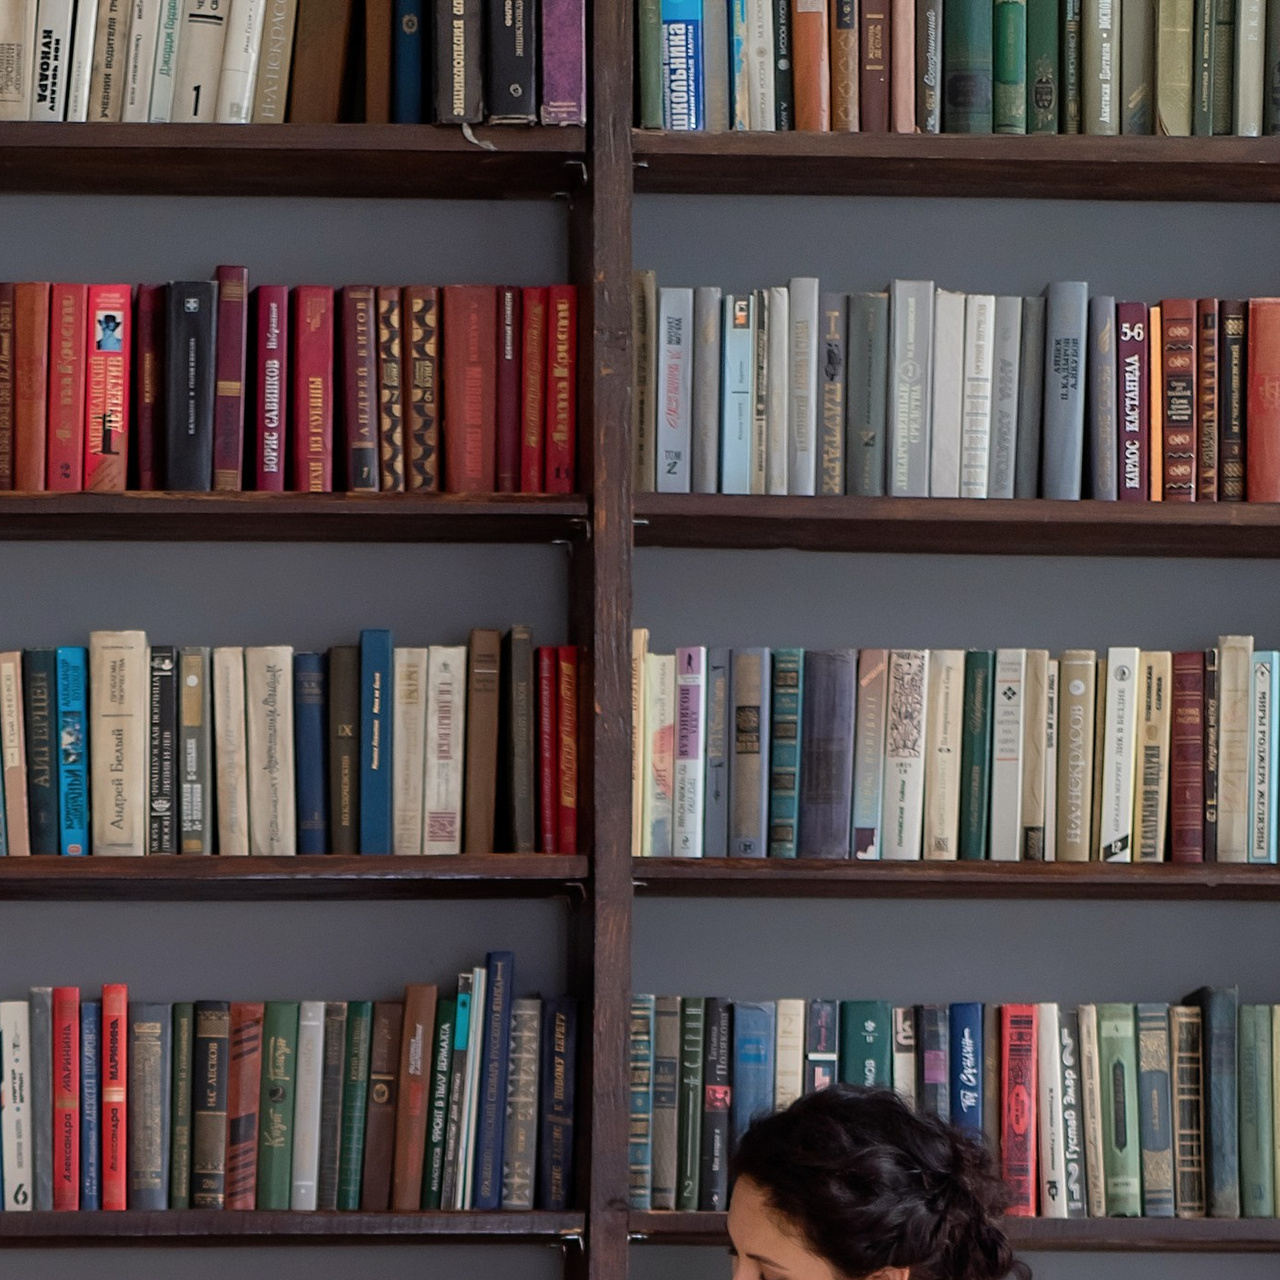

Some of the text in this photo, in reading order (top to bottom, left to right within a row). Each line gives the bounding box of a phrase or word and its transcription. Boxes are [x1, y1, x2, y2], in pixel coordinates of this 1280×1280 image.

[669, 23, 688, 130] ШКОЛЬНИКА
[265, 359, 280, 428] САВИНКОВ
[355, 301, 369, 436] АНДРЕЙ БИТОВ
[89, 355, 122, 455] АМЕРИКАНСКИЙ ДЕТЕКТИВ
[308, 377, 322, 433] ГЛУБИНЫ
[1123, 355, 1140, 488] КАРЛОС КАСТАНЕДА
[263, 431, 280, 472] БОРИС
[309, 435, 322, 451] ИЗ
[109, 661, 118, 703] ПРОБЛЕМЫ
[117, 658, 126, 705] ТВОРЧЕСТВА
[151, 676, 162, 796] ФРАНЦУЗСКАЯ ВОЛЧИЦА
[677, 688, 690, 757] ПОЛЯНСКАЯ
[690, 709, 698, 737] АЛЛА
[109, 728, 127, 831] Андрей Белый
[1256, 691, 1268, 851] МИРЫ РОДЖЕРА ЖЕЛЯЗНЫ
[436, 1022, 451, 1071] ВЕРМАХТА
[709, 1027, 719, 1061] Татьяна
[434, 1070, 447, 1097] ТЫЛУ
[1062, 1069, 1077, 1159] Густав Эмар
[430, 1111, 442, 1143] ФРОНТ
